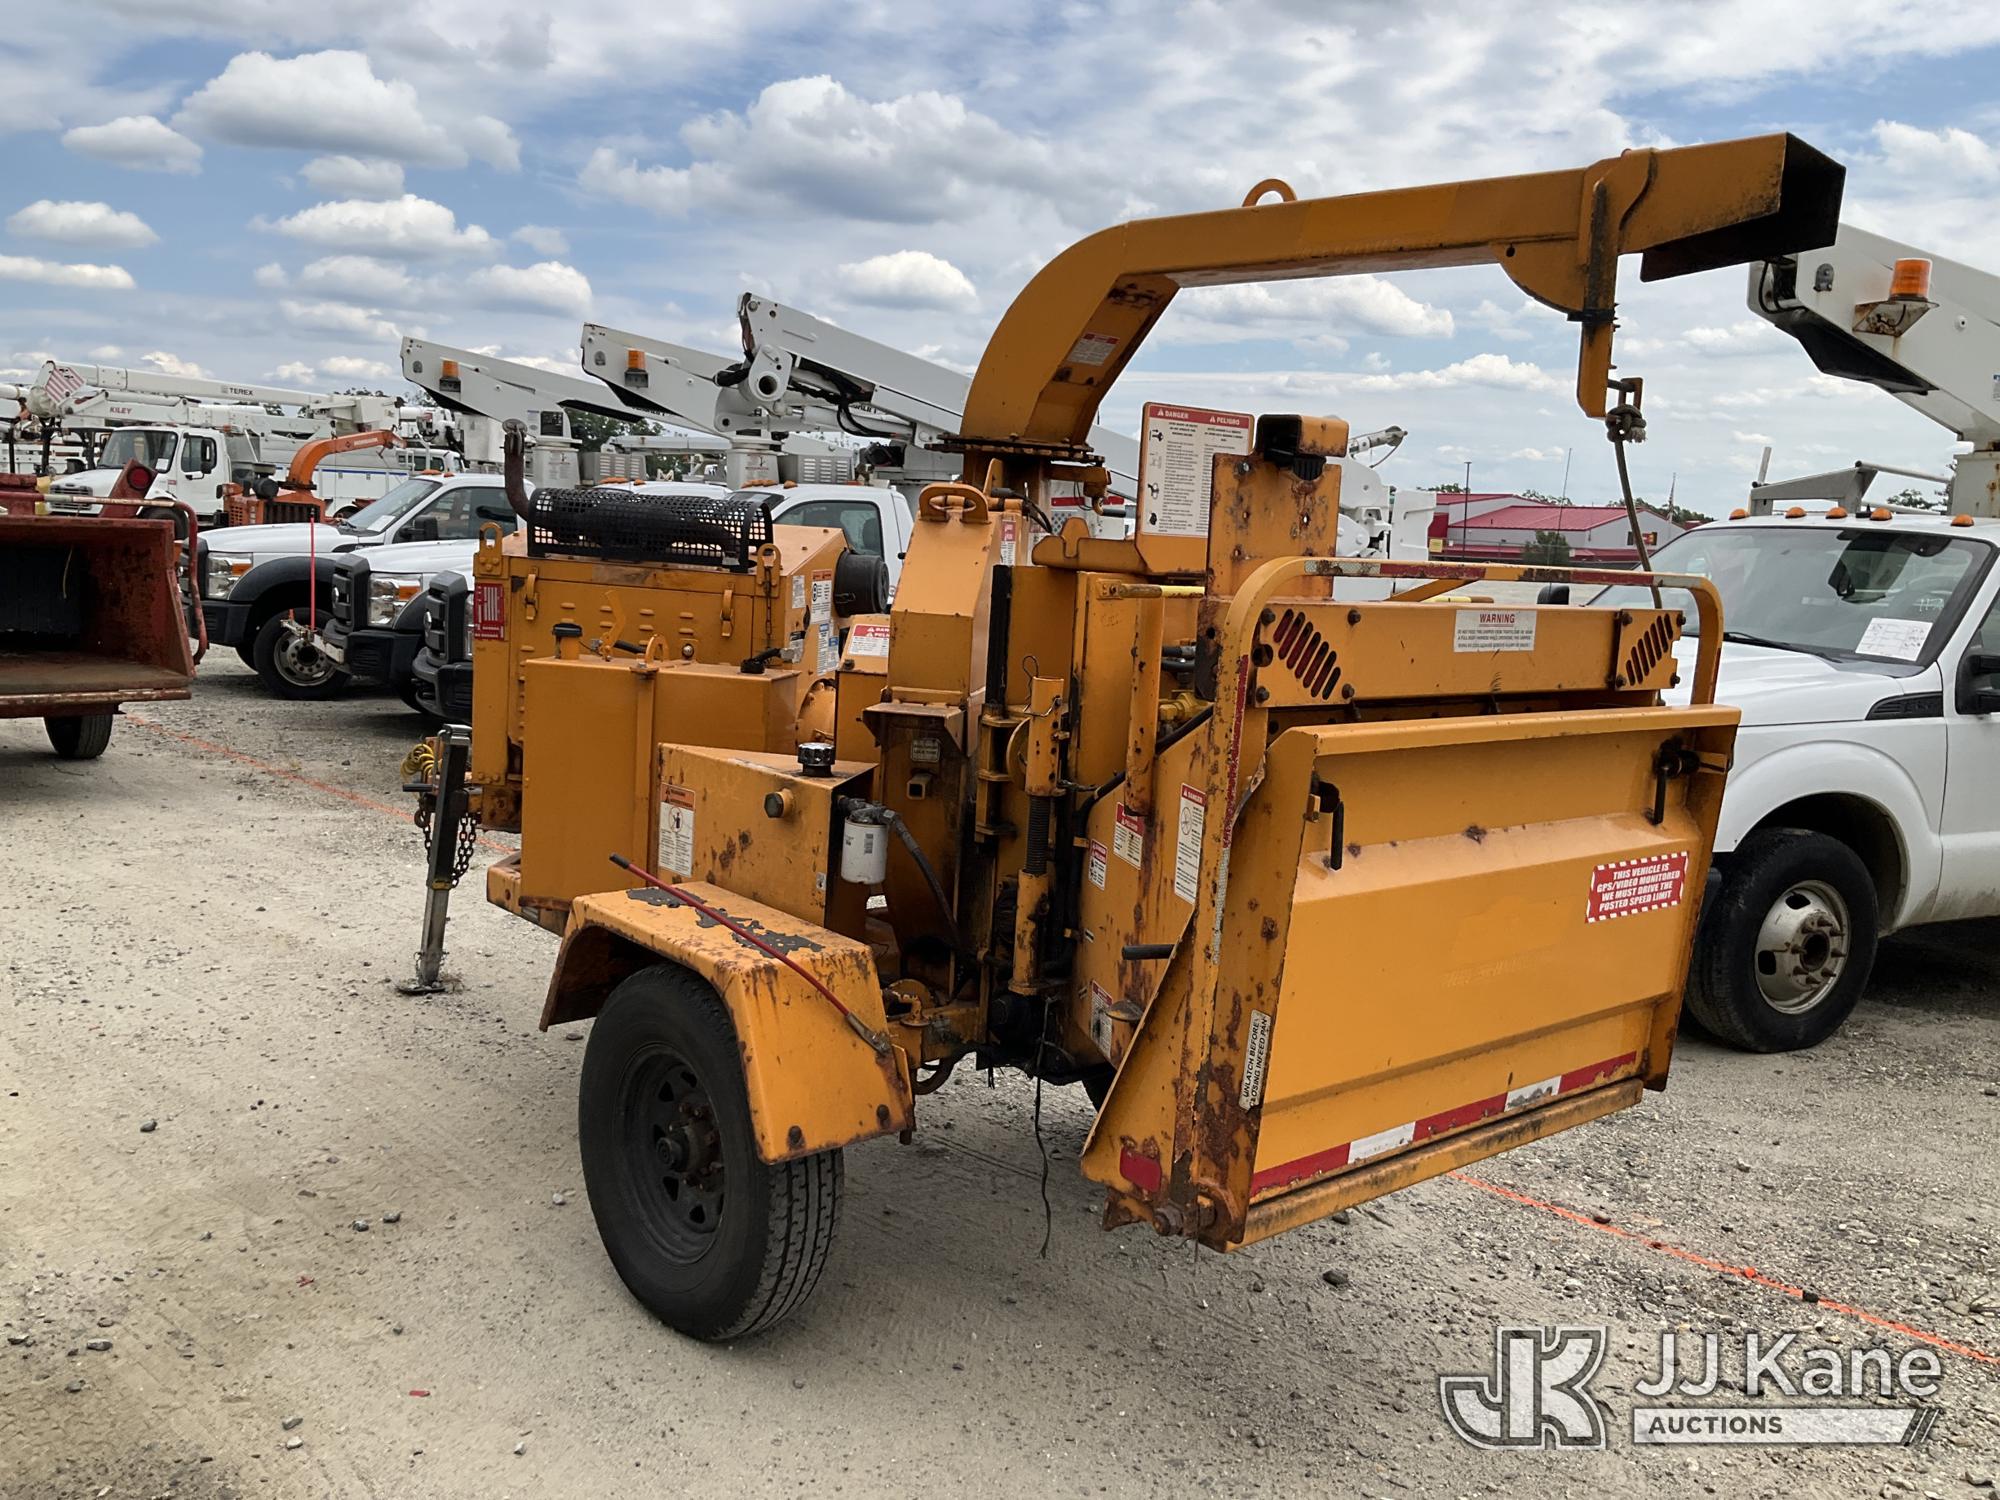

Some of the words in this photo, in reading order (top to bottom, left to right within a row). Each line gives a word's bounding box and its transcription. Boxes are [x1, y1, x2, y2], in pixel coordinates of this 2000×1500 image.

[110, 406, 132, 416] KILEY
[1165, 411, 1189, 419] DANGER
[1217, 417, 1240, 425] PELIGRO
[1480, 614, 1515, 623] WARNING
[1613, 869, 1631, 880] THIS
[1632, 865, 1661, 877] VEHICLE
[1661, 863, 1670, 871] IS
[1596, 878, 1639, 893] GPS/VIDEO
[1639, 870, 1681, 885] MONITORED
[1601, 892, 1614, 902] WE
[1615, 888, 1637, 899] MUST
[1637, 883, 1659, 895] DRIVE
[1660, 880, 1673, 890] THE
[1599, 900, 1629, 912] POSTED
[1629, 895, 1652, 906] SPEED
[1652, 890, 1673, 901] LIMIT
[1260, 1019, 1268, 1036] PAN
[1243, 1058, 1255, 1098] UNLATCH
[1249, 1021, 1260, 1057] BEFORE
[1256, 1037, 1266, 1069] INFEED
